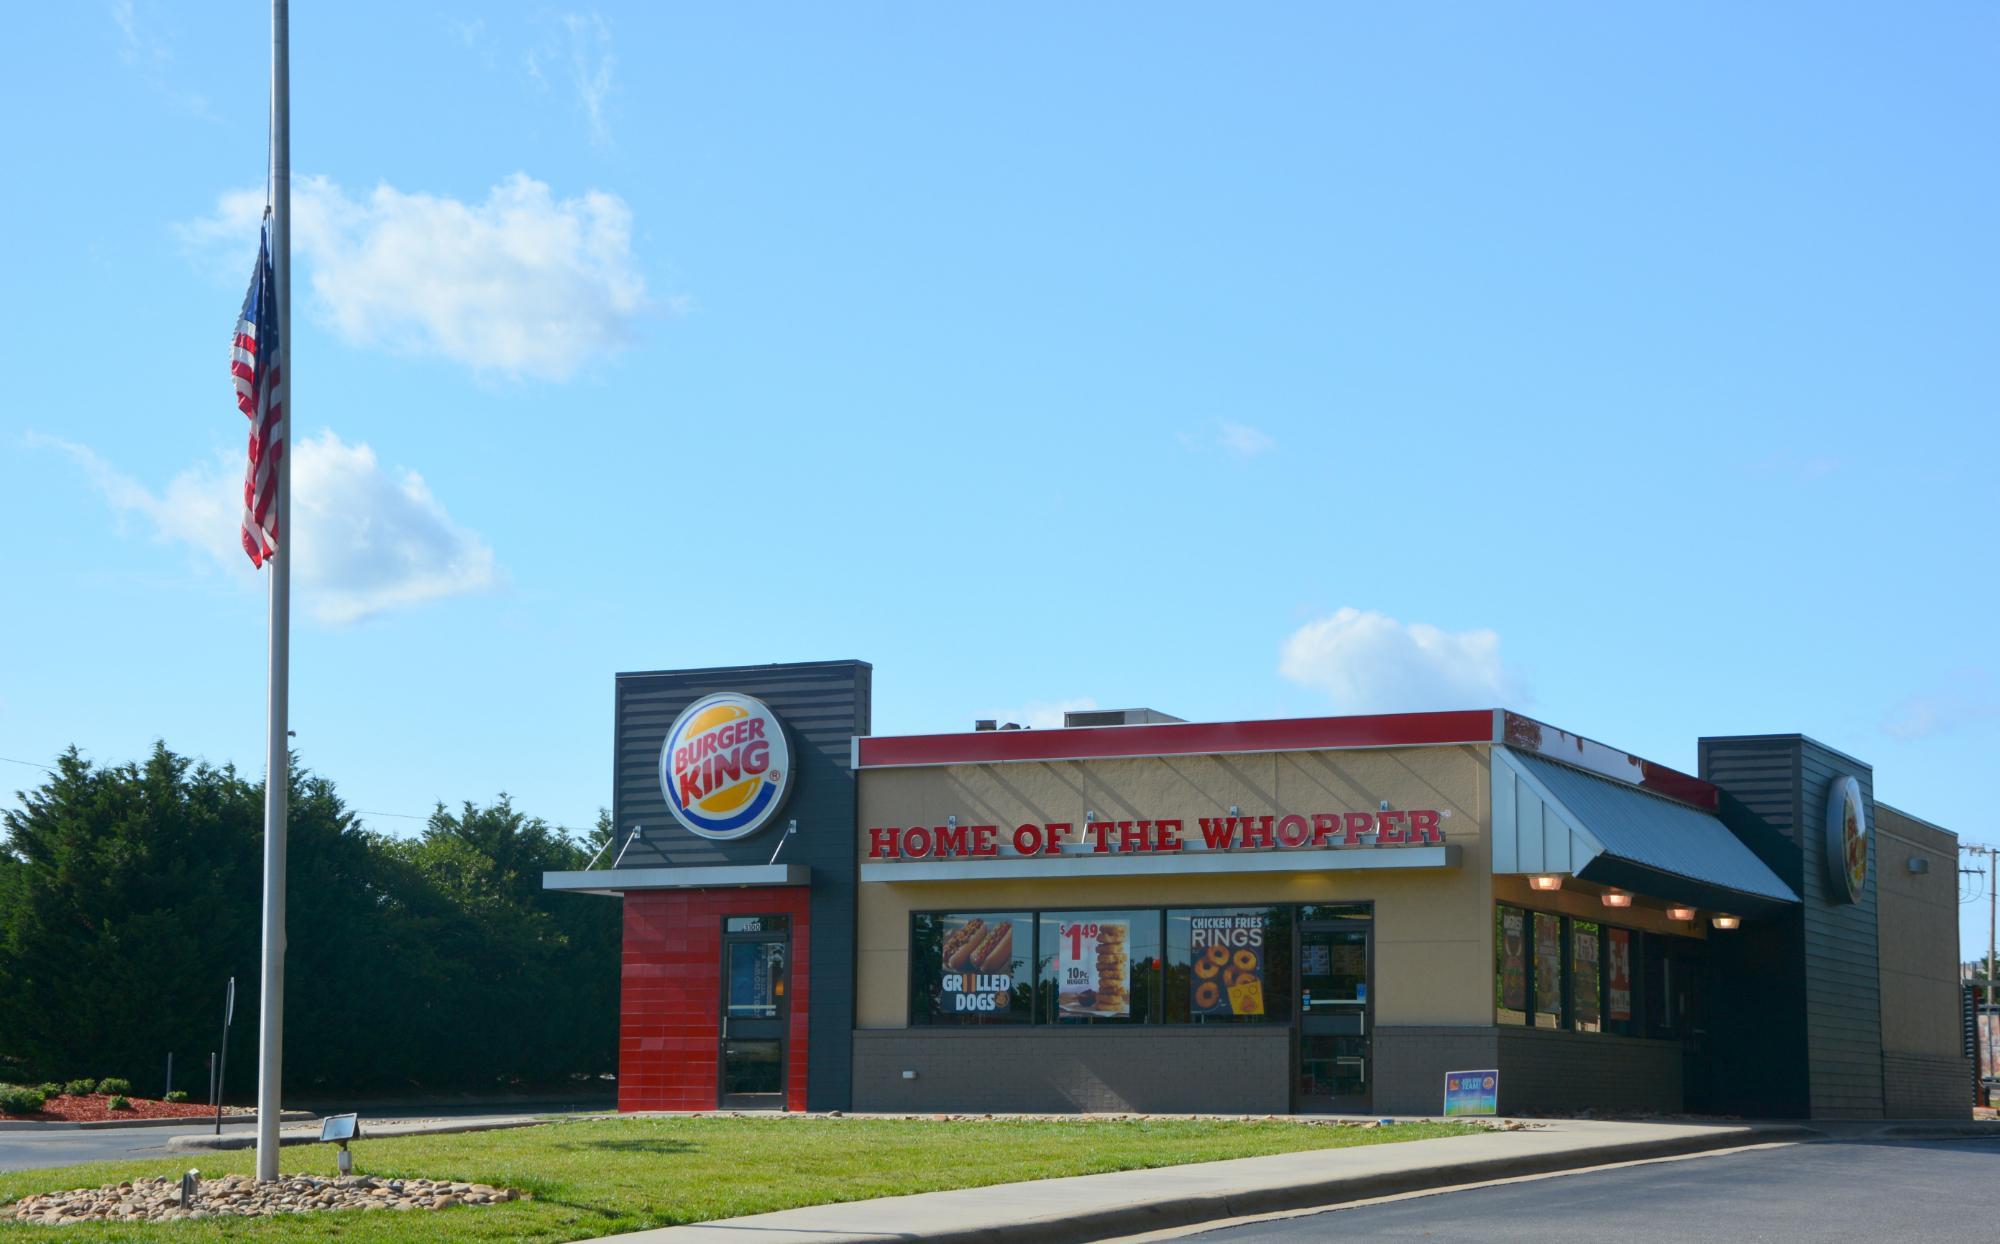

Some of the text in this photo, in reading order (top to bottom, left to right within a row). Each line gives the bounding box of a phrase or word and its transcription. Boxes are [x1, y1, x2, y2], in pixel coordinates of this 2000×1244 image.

[676, 718, 765, 775] BURGER
[680, 740, 769, 809] KING
[869, 809, 1442, 858] HOME OF THE WHOPPER
[1192, 917, 1262, 928] CHICKEN FRIES
[1192, 928, 1262, 948] RINGS
[942, 974, 1010, 992] GRILLED
[956, 993, 996, 1011] DOGS
